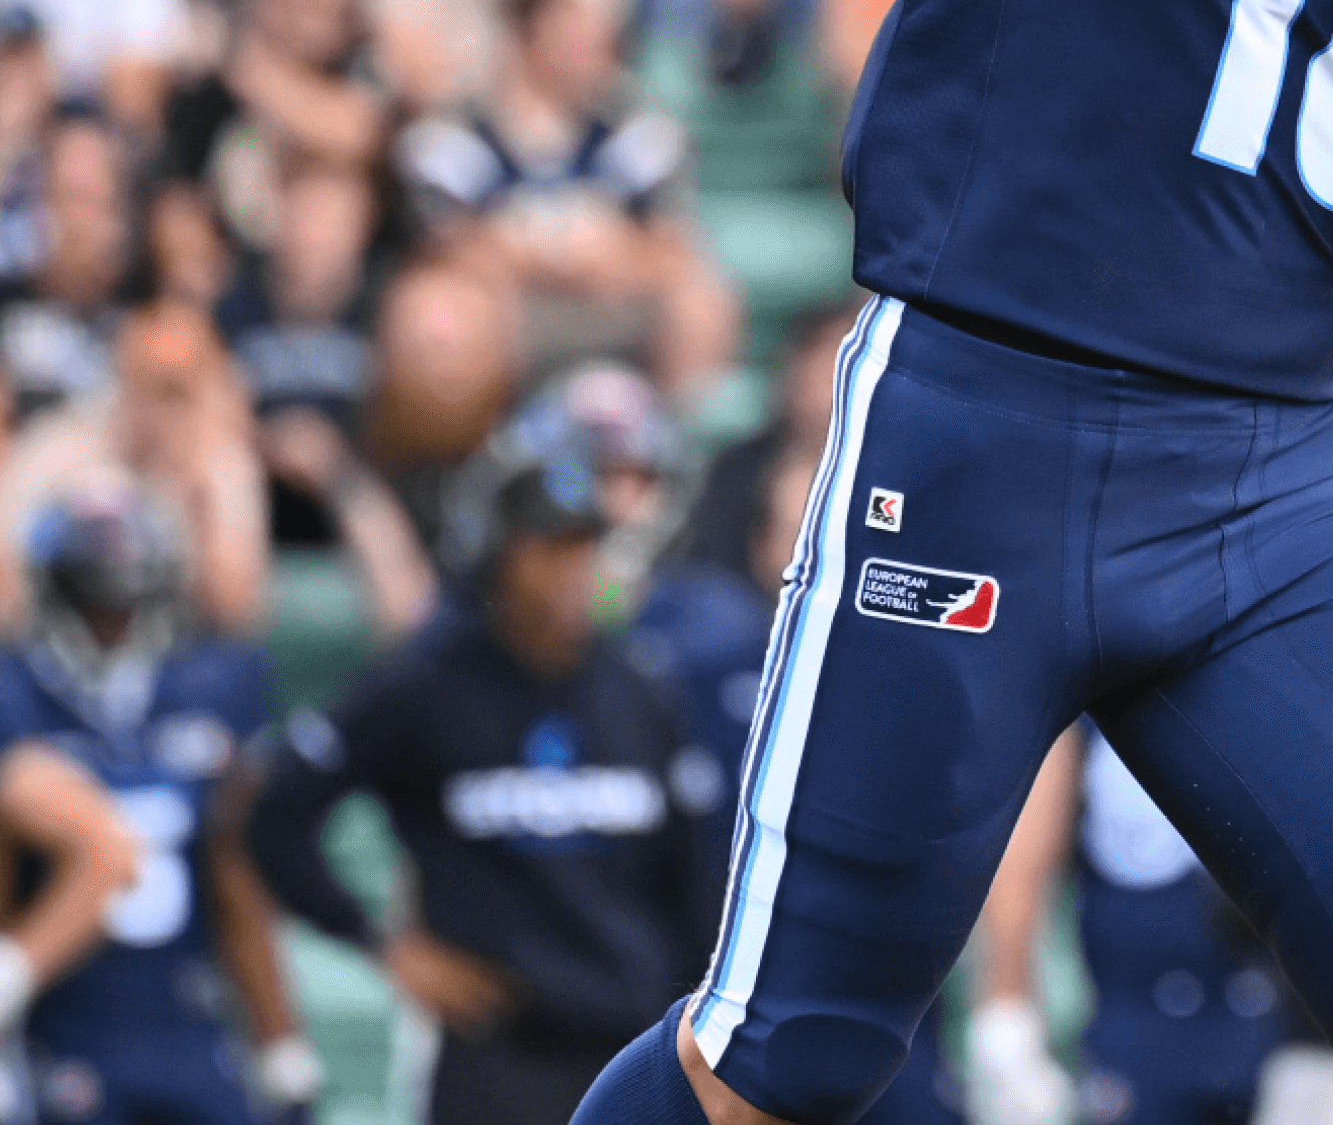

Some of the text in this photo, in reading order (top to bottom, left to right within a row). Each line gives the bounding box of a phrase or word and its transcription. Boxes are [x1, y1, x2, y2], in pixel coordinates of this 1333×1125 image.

[865, 579, 907, 597] LEAGUE
[868, 567, 929, 590] EUROPEAN
[862, 591, 920, 613] FOOTBALL
